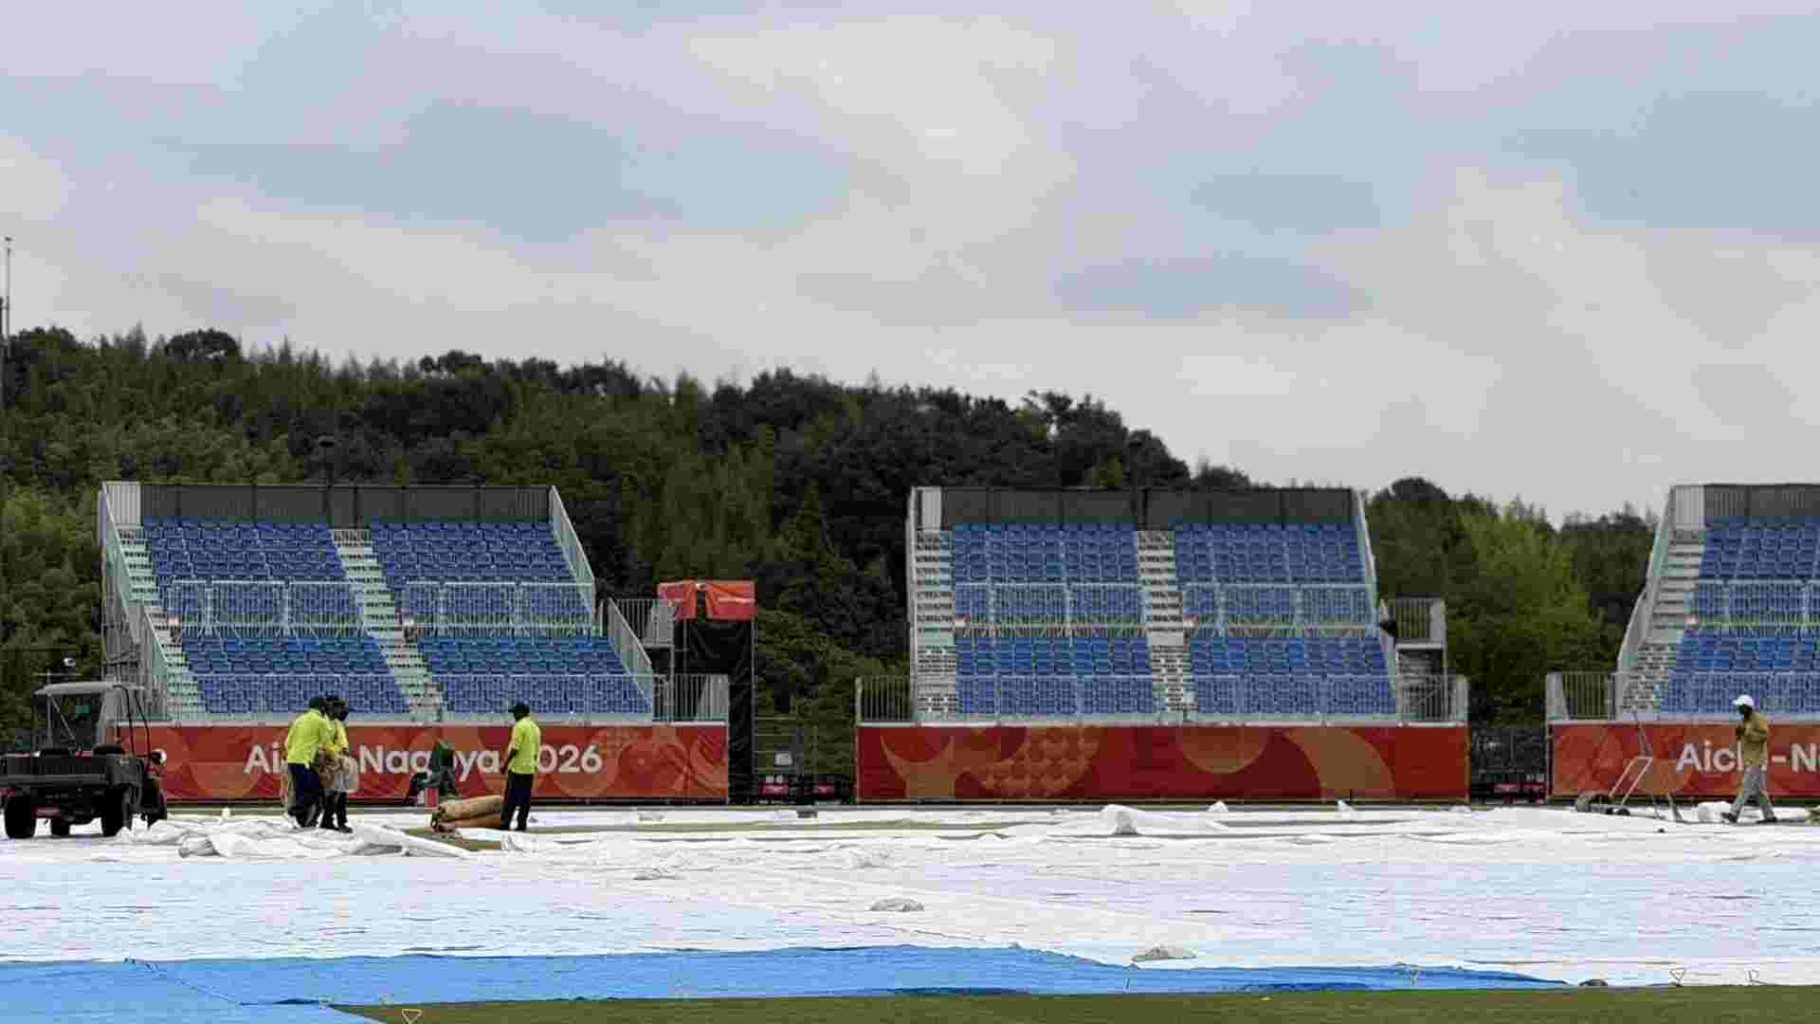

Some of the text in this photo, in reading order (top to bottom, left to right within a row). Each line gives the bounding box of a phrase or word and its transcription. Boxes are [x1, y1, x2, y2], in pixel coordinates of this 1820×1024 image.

[243, 740, 602, 782] AiNagya 026
[1675, 740, 1820, 773] Aic-N
